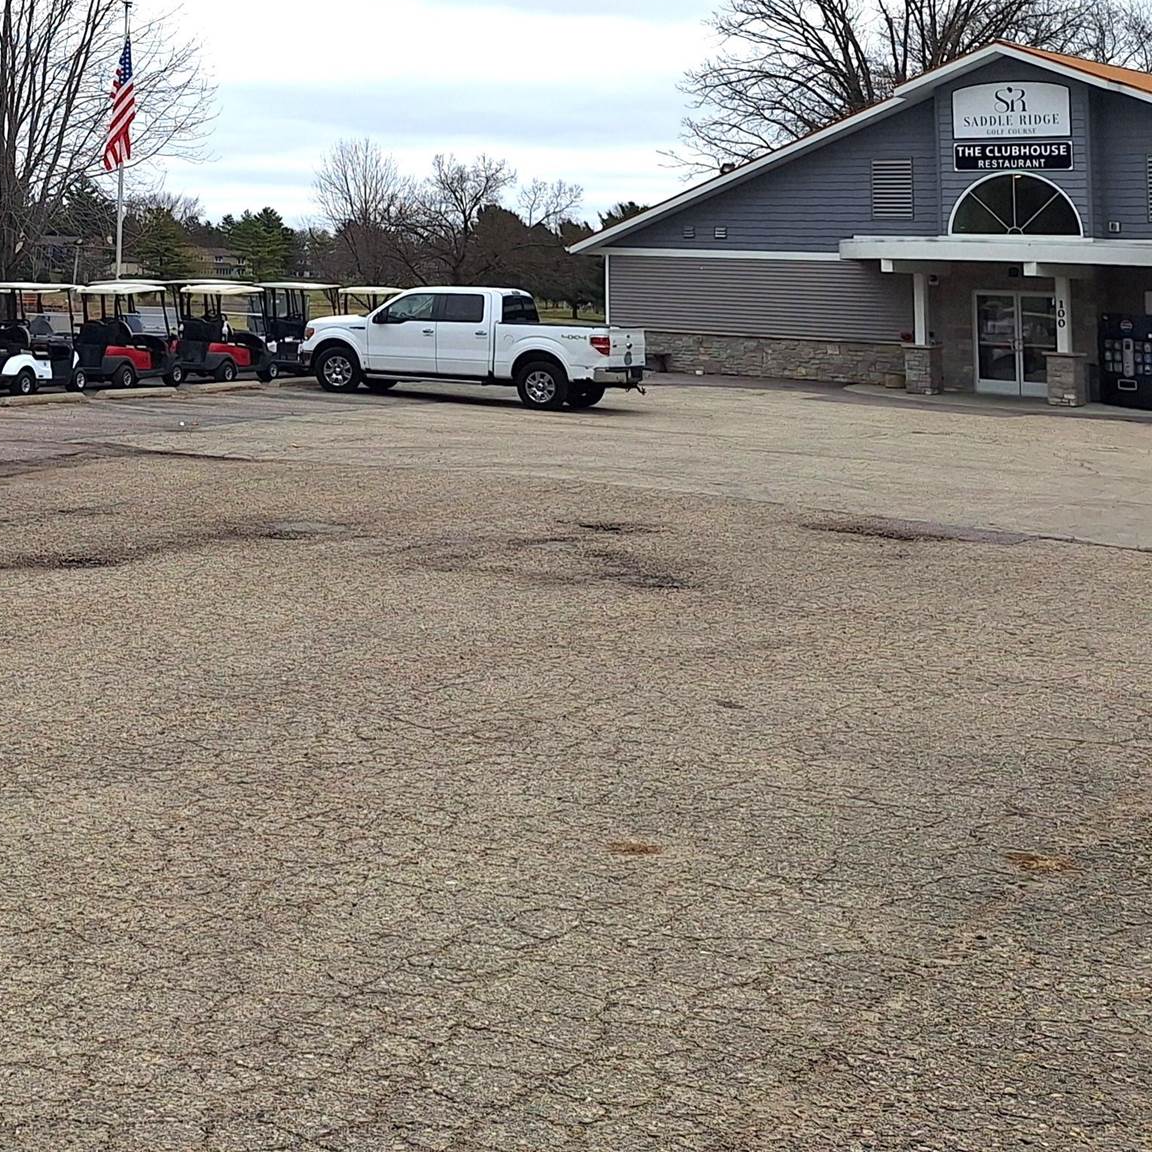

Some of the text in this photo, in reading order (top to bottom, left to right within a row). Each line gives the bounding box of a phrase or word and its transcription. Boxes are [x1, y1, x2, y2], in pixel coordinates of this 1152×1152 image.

[963, 113, 1060, 127] SADDLE RIDGE
[986, 128, 1005, 136] GOLF
[956, 144, 1068, 157] THE CLUBHOUSE
[977, 158, 1046, 168] RESTAURANT
[1057, 299, 1066, 328] 100
